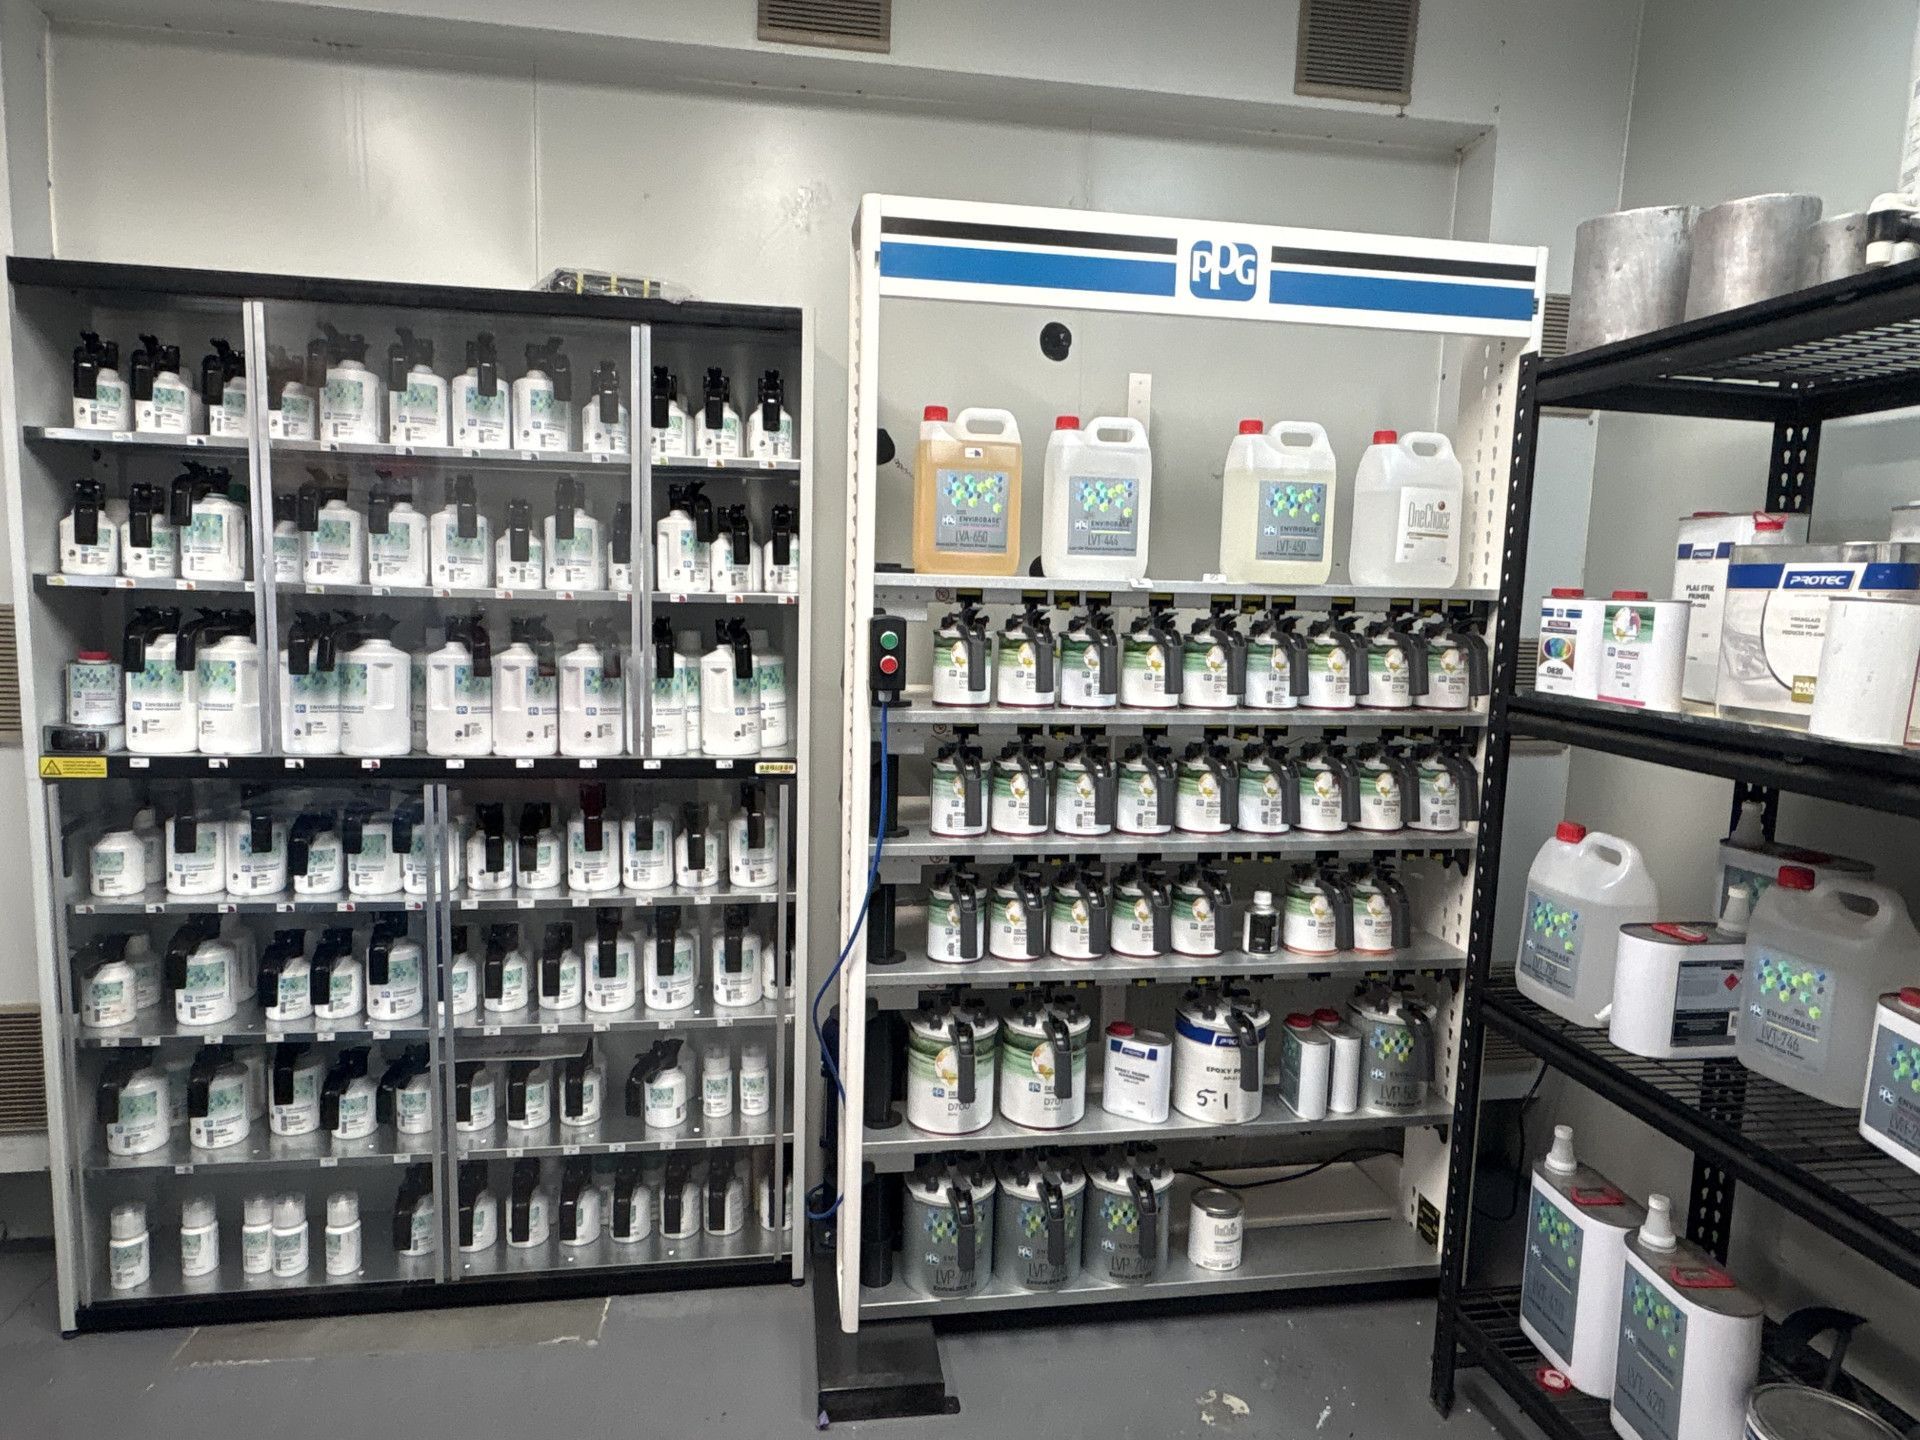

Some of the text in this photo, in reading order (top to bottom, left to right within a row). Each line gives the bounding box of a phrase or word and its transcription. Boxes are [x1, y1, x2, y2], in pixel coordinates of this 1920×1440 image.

[1191, 241, 1256, 292] PPG
[1408, 501, 1451, 530] OneChoice
[955, 530, 988, 543] LVA-650
[1790, 575, 1848, 585] PROTEC
[1766, 1008, 1820, 1031] ENVIROBASE
[1761, 1023, 1799, 1052] LVT-746
[1206, 1066, 1231, 1075] EPOXY
